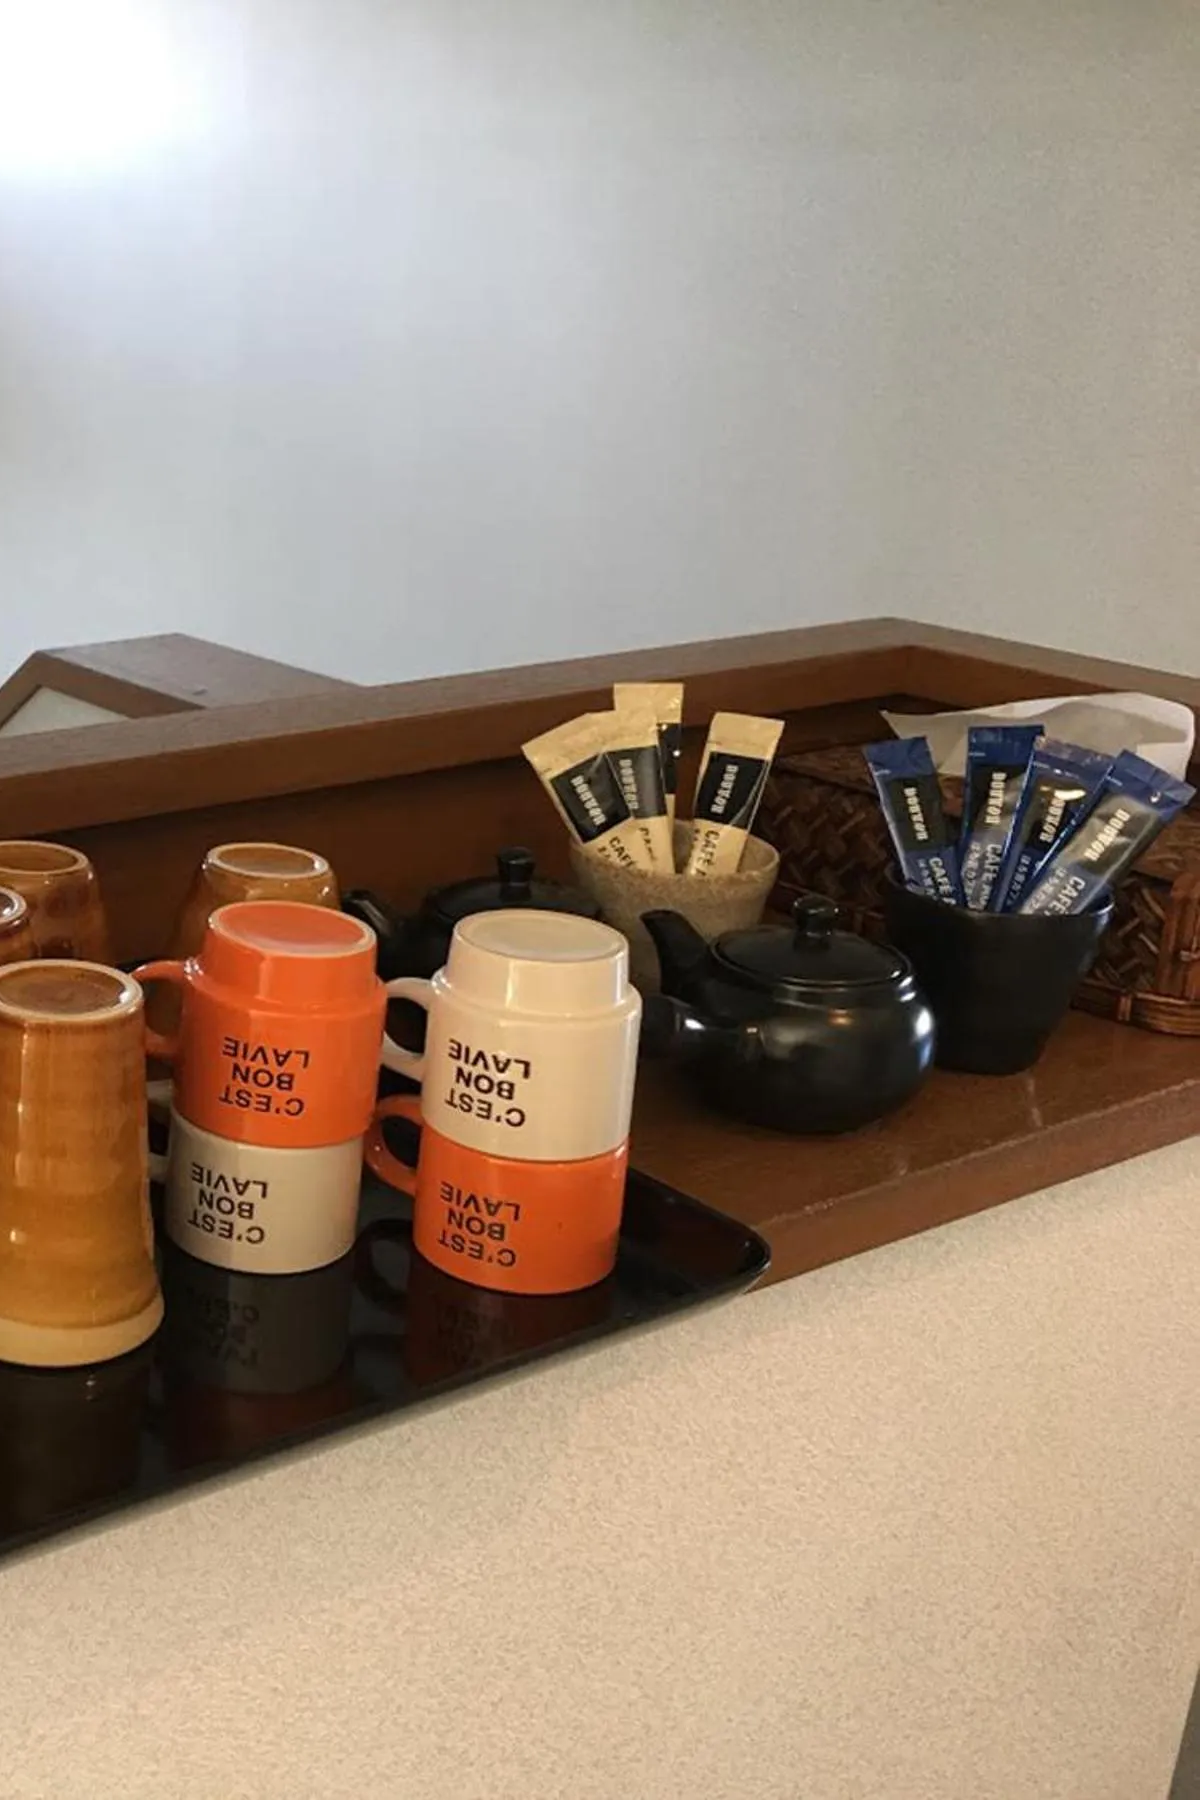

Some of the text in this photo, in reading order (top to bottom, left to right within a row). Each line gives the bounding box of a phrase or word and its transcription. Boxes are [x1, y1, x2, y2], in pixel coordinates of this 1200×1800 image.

[222, 1036, 310, 1069] LAVIE
[448, 1038, 531, 1079] LAVIE
[232, 1063, 294, 1091] BON
[456, 1066, 515, 1100] BON
[220, 1086, 304, 1117] C'EST
[445, 1087, 526, 1127] C'EST
[191, 1162, 267, 1199] LAVIE
[199, 1190, 254, 1220] BON
[440, 1181, 520, 1222] LAVIE
[188, 1213, 265, 1245] C'EST
[447, 1209, 506, 1242] BON
[438, 1230, 517, 1268] C'EST
